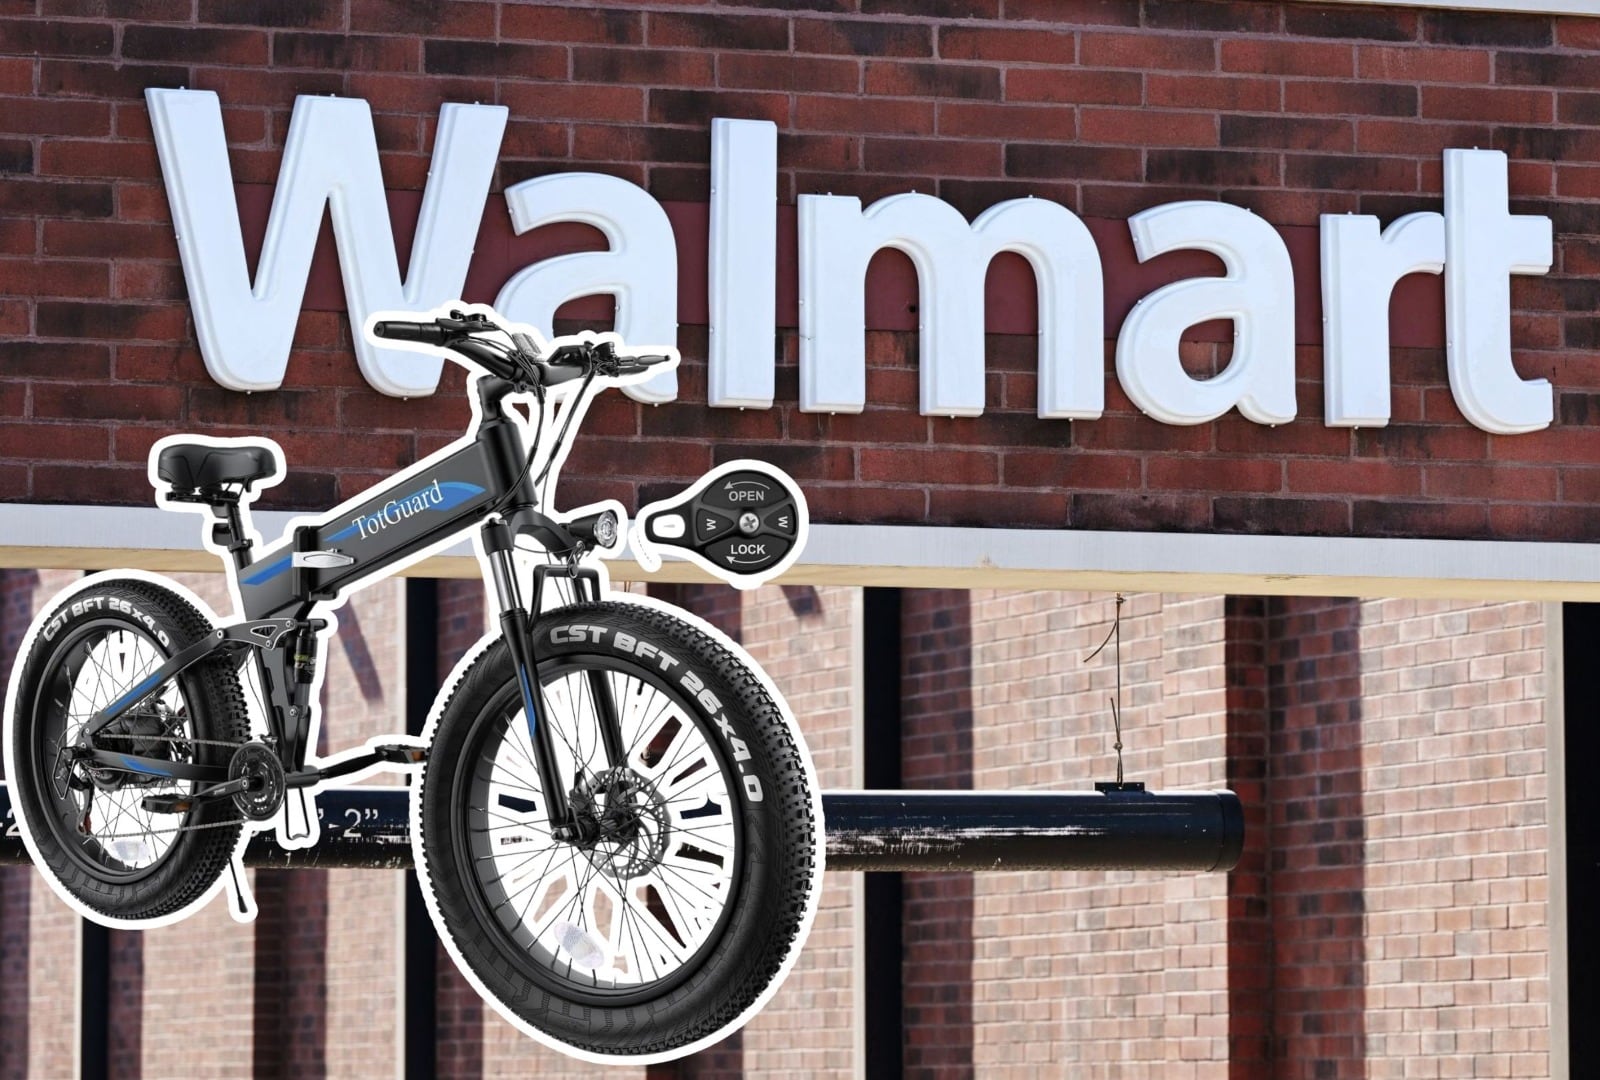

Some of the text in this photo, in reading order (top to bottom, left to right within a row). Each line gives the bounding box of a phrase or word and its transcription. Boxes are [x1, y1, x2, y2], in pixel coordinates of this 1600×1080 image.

[144, 85, 1556, 437] Walmart
[351, 478, 444, 541] TotGuard
[728, 490, 765, 502] OPEN
[730, 543, 766, 556] LOCK
[43, 596, 170, 648] CST BFT 26x4.0
[550, 624, 764, 803] CST BFT 26x4.0
